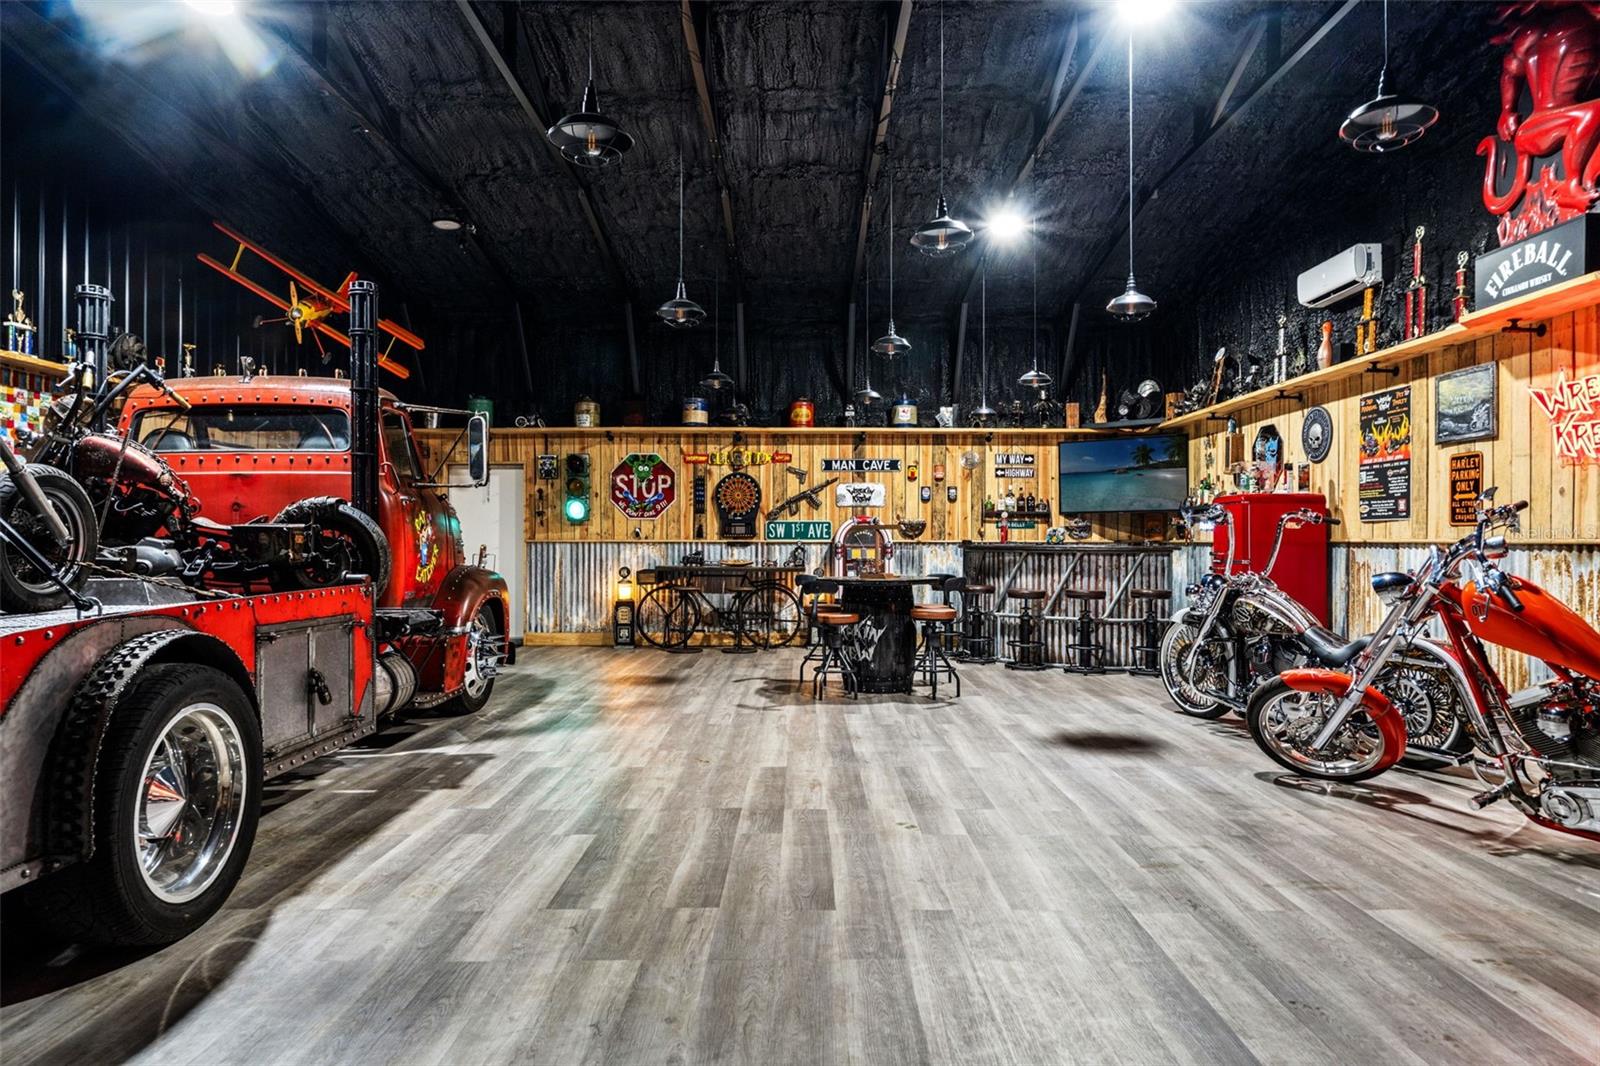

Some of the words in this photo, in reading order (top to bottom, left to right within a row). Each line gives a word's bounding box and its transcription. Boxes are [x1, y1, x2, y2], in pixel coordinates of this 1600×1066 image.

[1484, 240, 1572, 299] FIREBALL
[1502, 280, 1529, 297] CINNAMON
[831, 460, 856, 470] MAN
[862, 460, 891, 470] CAVE
[996, 454, 1007, 464] MY
[1008, 454, 1025, 464] WAY
[1451, 458, 1480, 470] HARLEY
[1004, 469, 1034, 477] HIGHWAY
[1451, 469, 1480, 480] PARKING
[615, 474, 672, 499] STOP
[1456, 480, 1475, 492] ONLY
[768, 524, 786, 538] SW
[791, 524, 805, 538] 1ST
[807, 524, 829, 538] AVE
